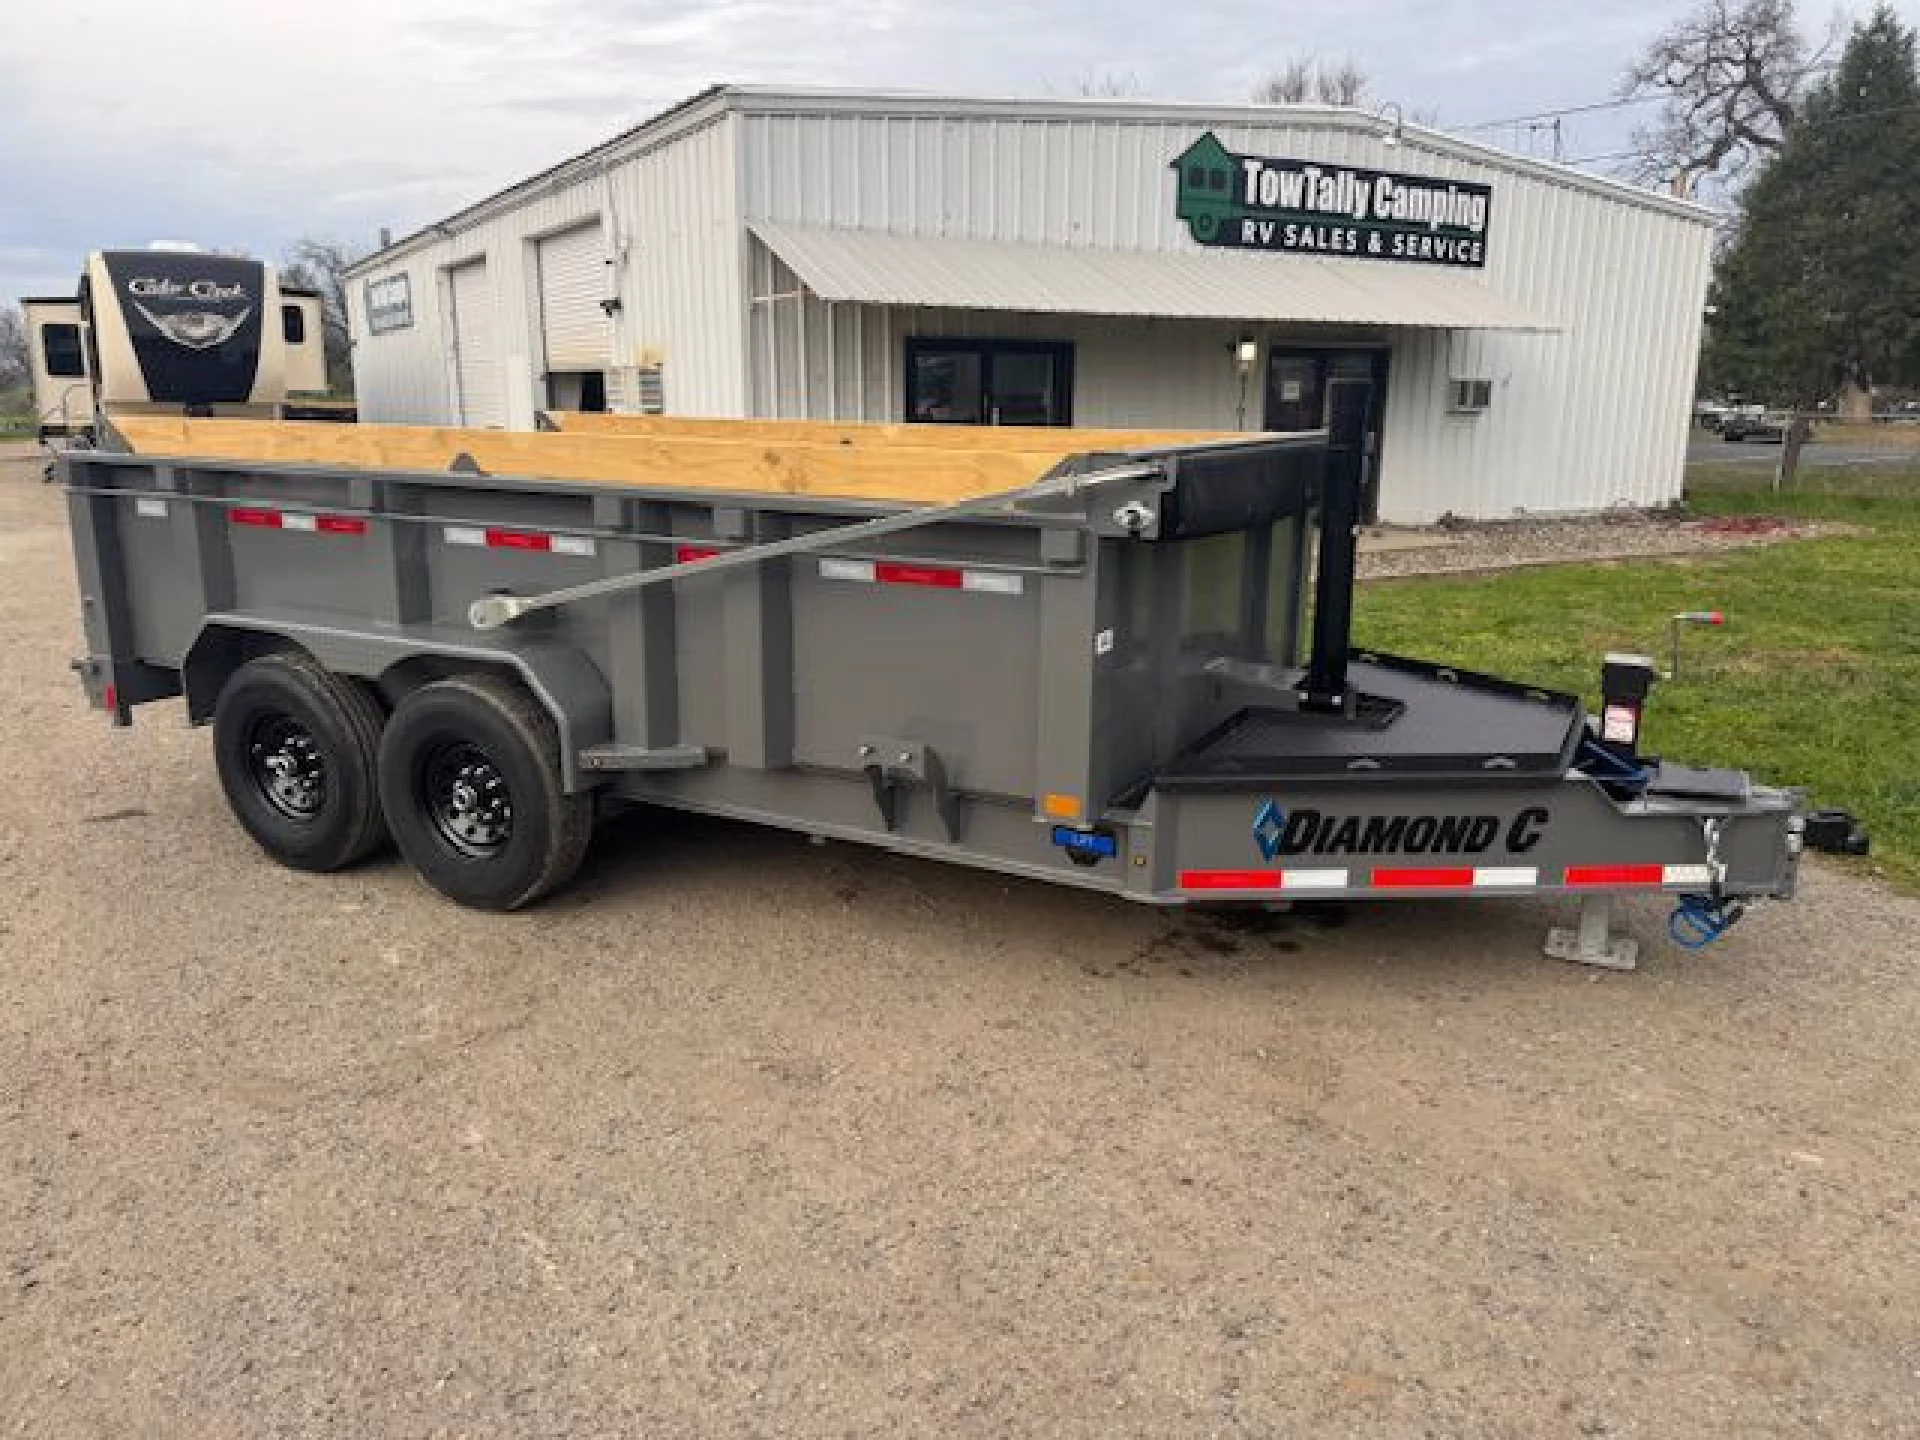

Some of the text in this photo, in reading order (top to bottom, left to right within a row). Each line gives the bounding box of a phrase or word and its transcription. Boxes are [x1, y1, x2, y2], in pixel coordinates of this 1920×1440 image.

[1374, 176, 1486, 231] Camping
[1241, 219, 1482, 262] RV SALES & SERVICE
[1277, 806, 1549, 855] DIAMOND C
